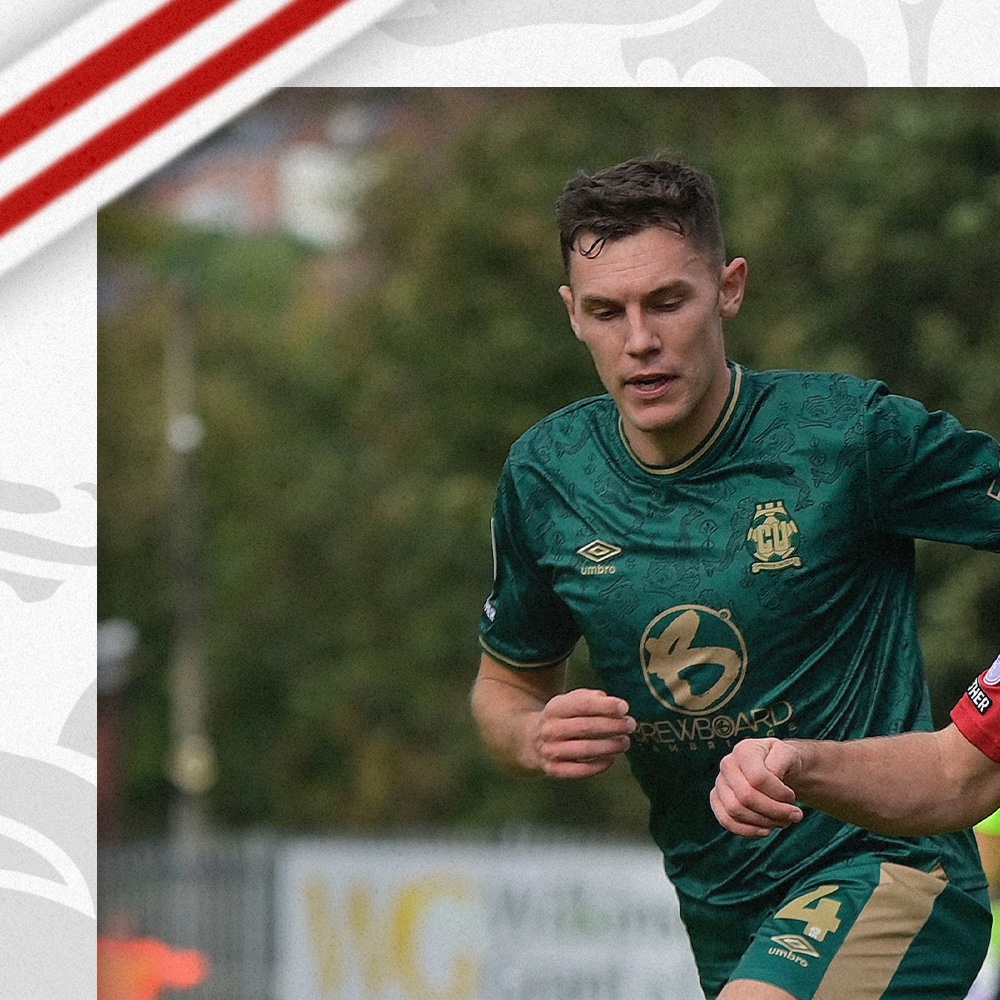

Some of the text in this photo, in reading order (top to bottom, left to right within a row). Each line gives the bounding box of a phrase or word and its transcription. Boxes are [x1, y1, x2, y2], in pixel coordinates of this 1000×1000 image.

[581, 564, 616, 576] umbro
[773, 884, 842, 942] 4
[768, 946, 809, 968] umbro
